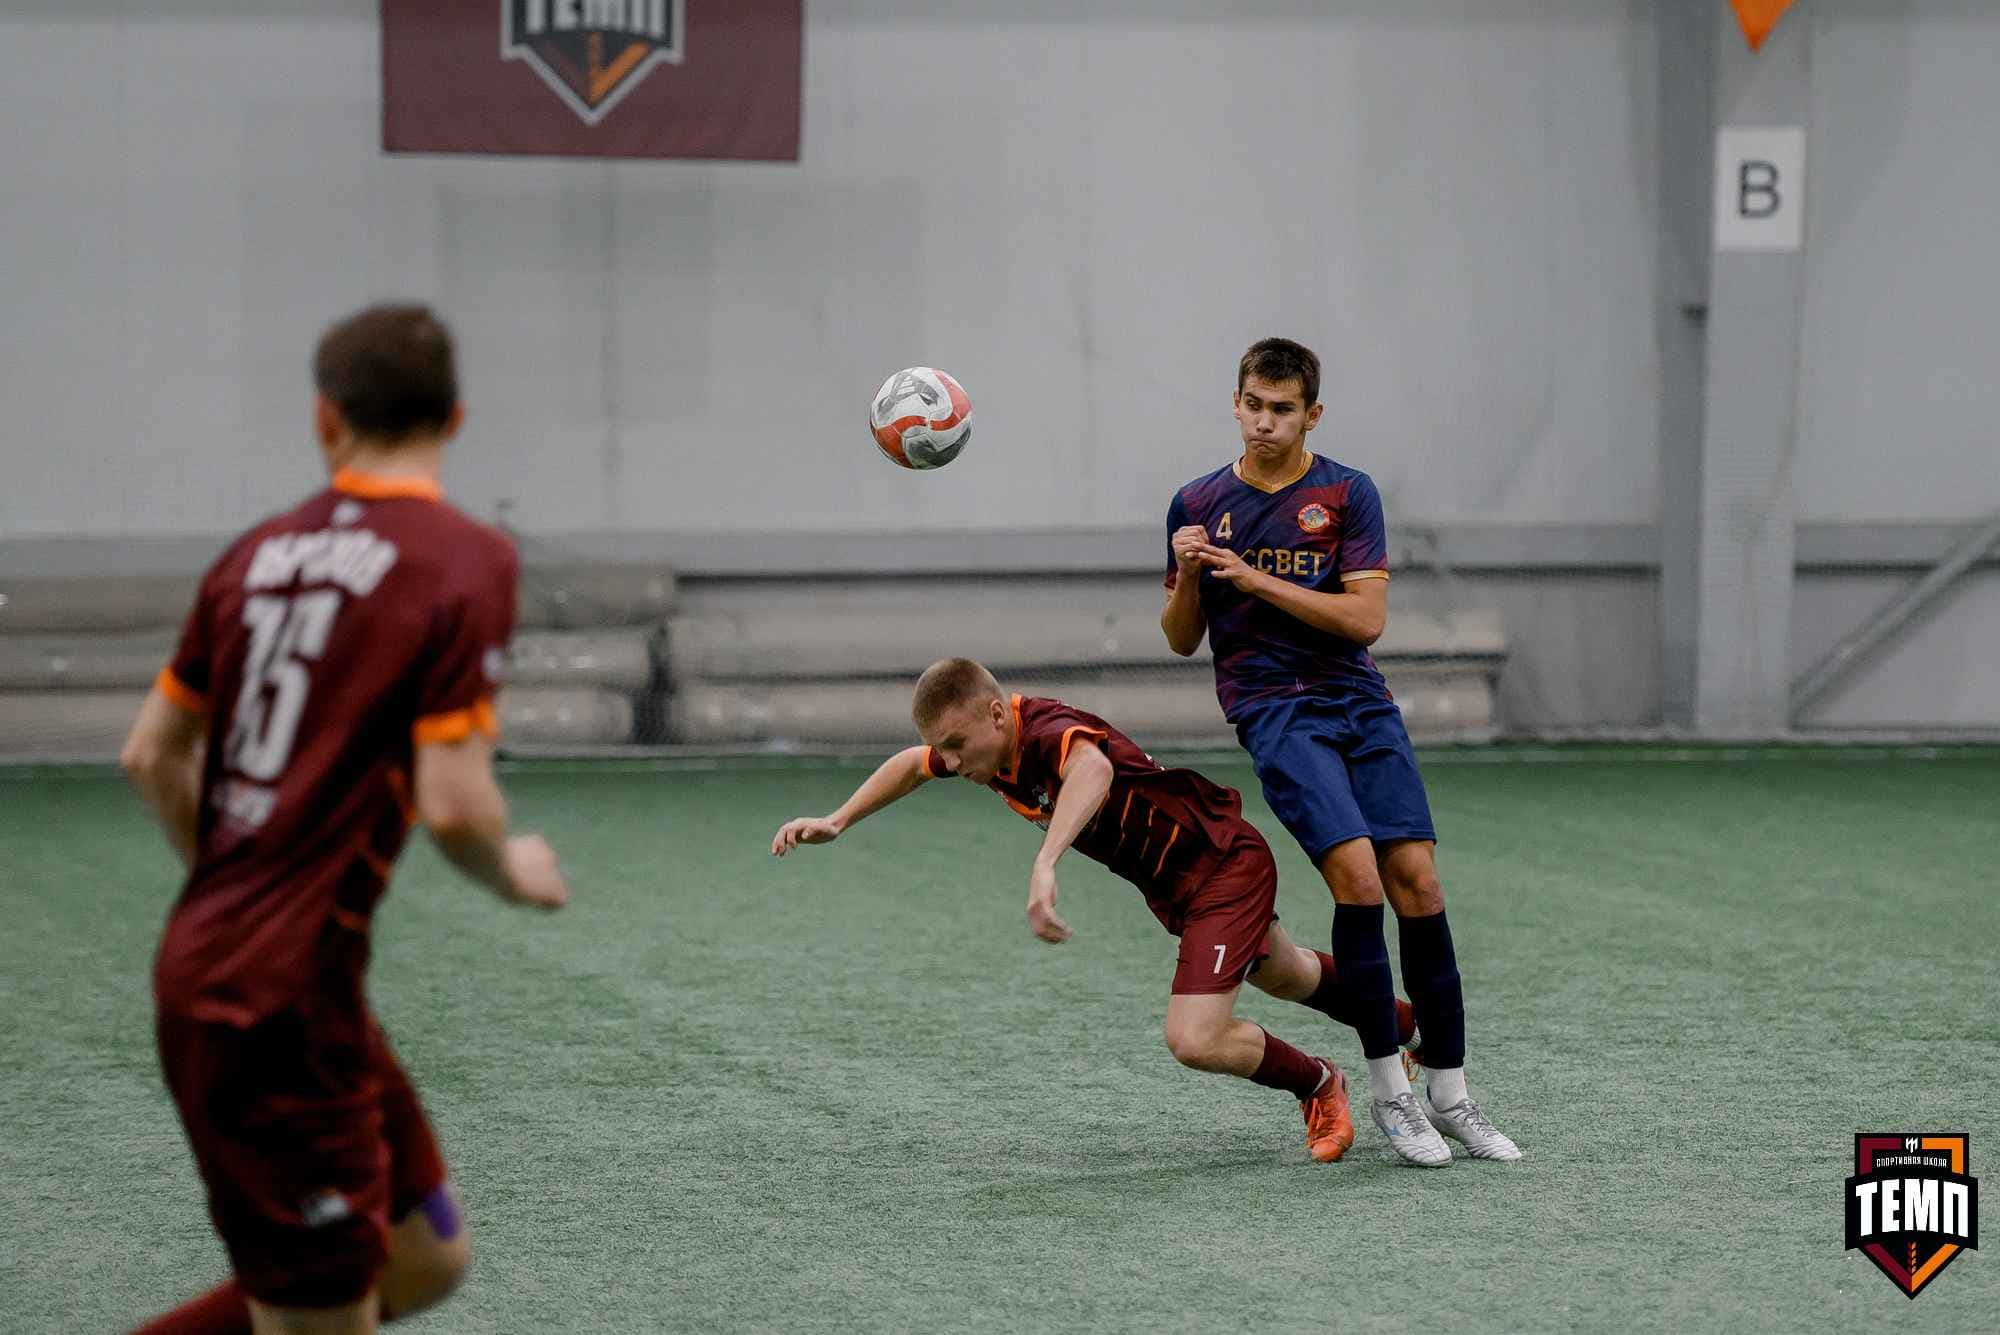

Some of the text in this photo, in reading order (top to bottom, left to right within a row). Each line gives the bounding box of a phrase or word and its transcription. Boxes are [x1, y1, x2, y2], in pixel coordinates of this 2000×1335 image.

[1216, 512, 1233, 540] 4
[1238, 548, 1326, 576] ССВЕТ
[1213, 944, 1226, 974] 7
